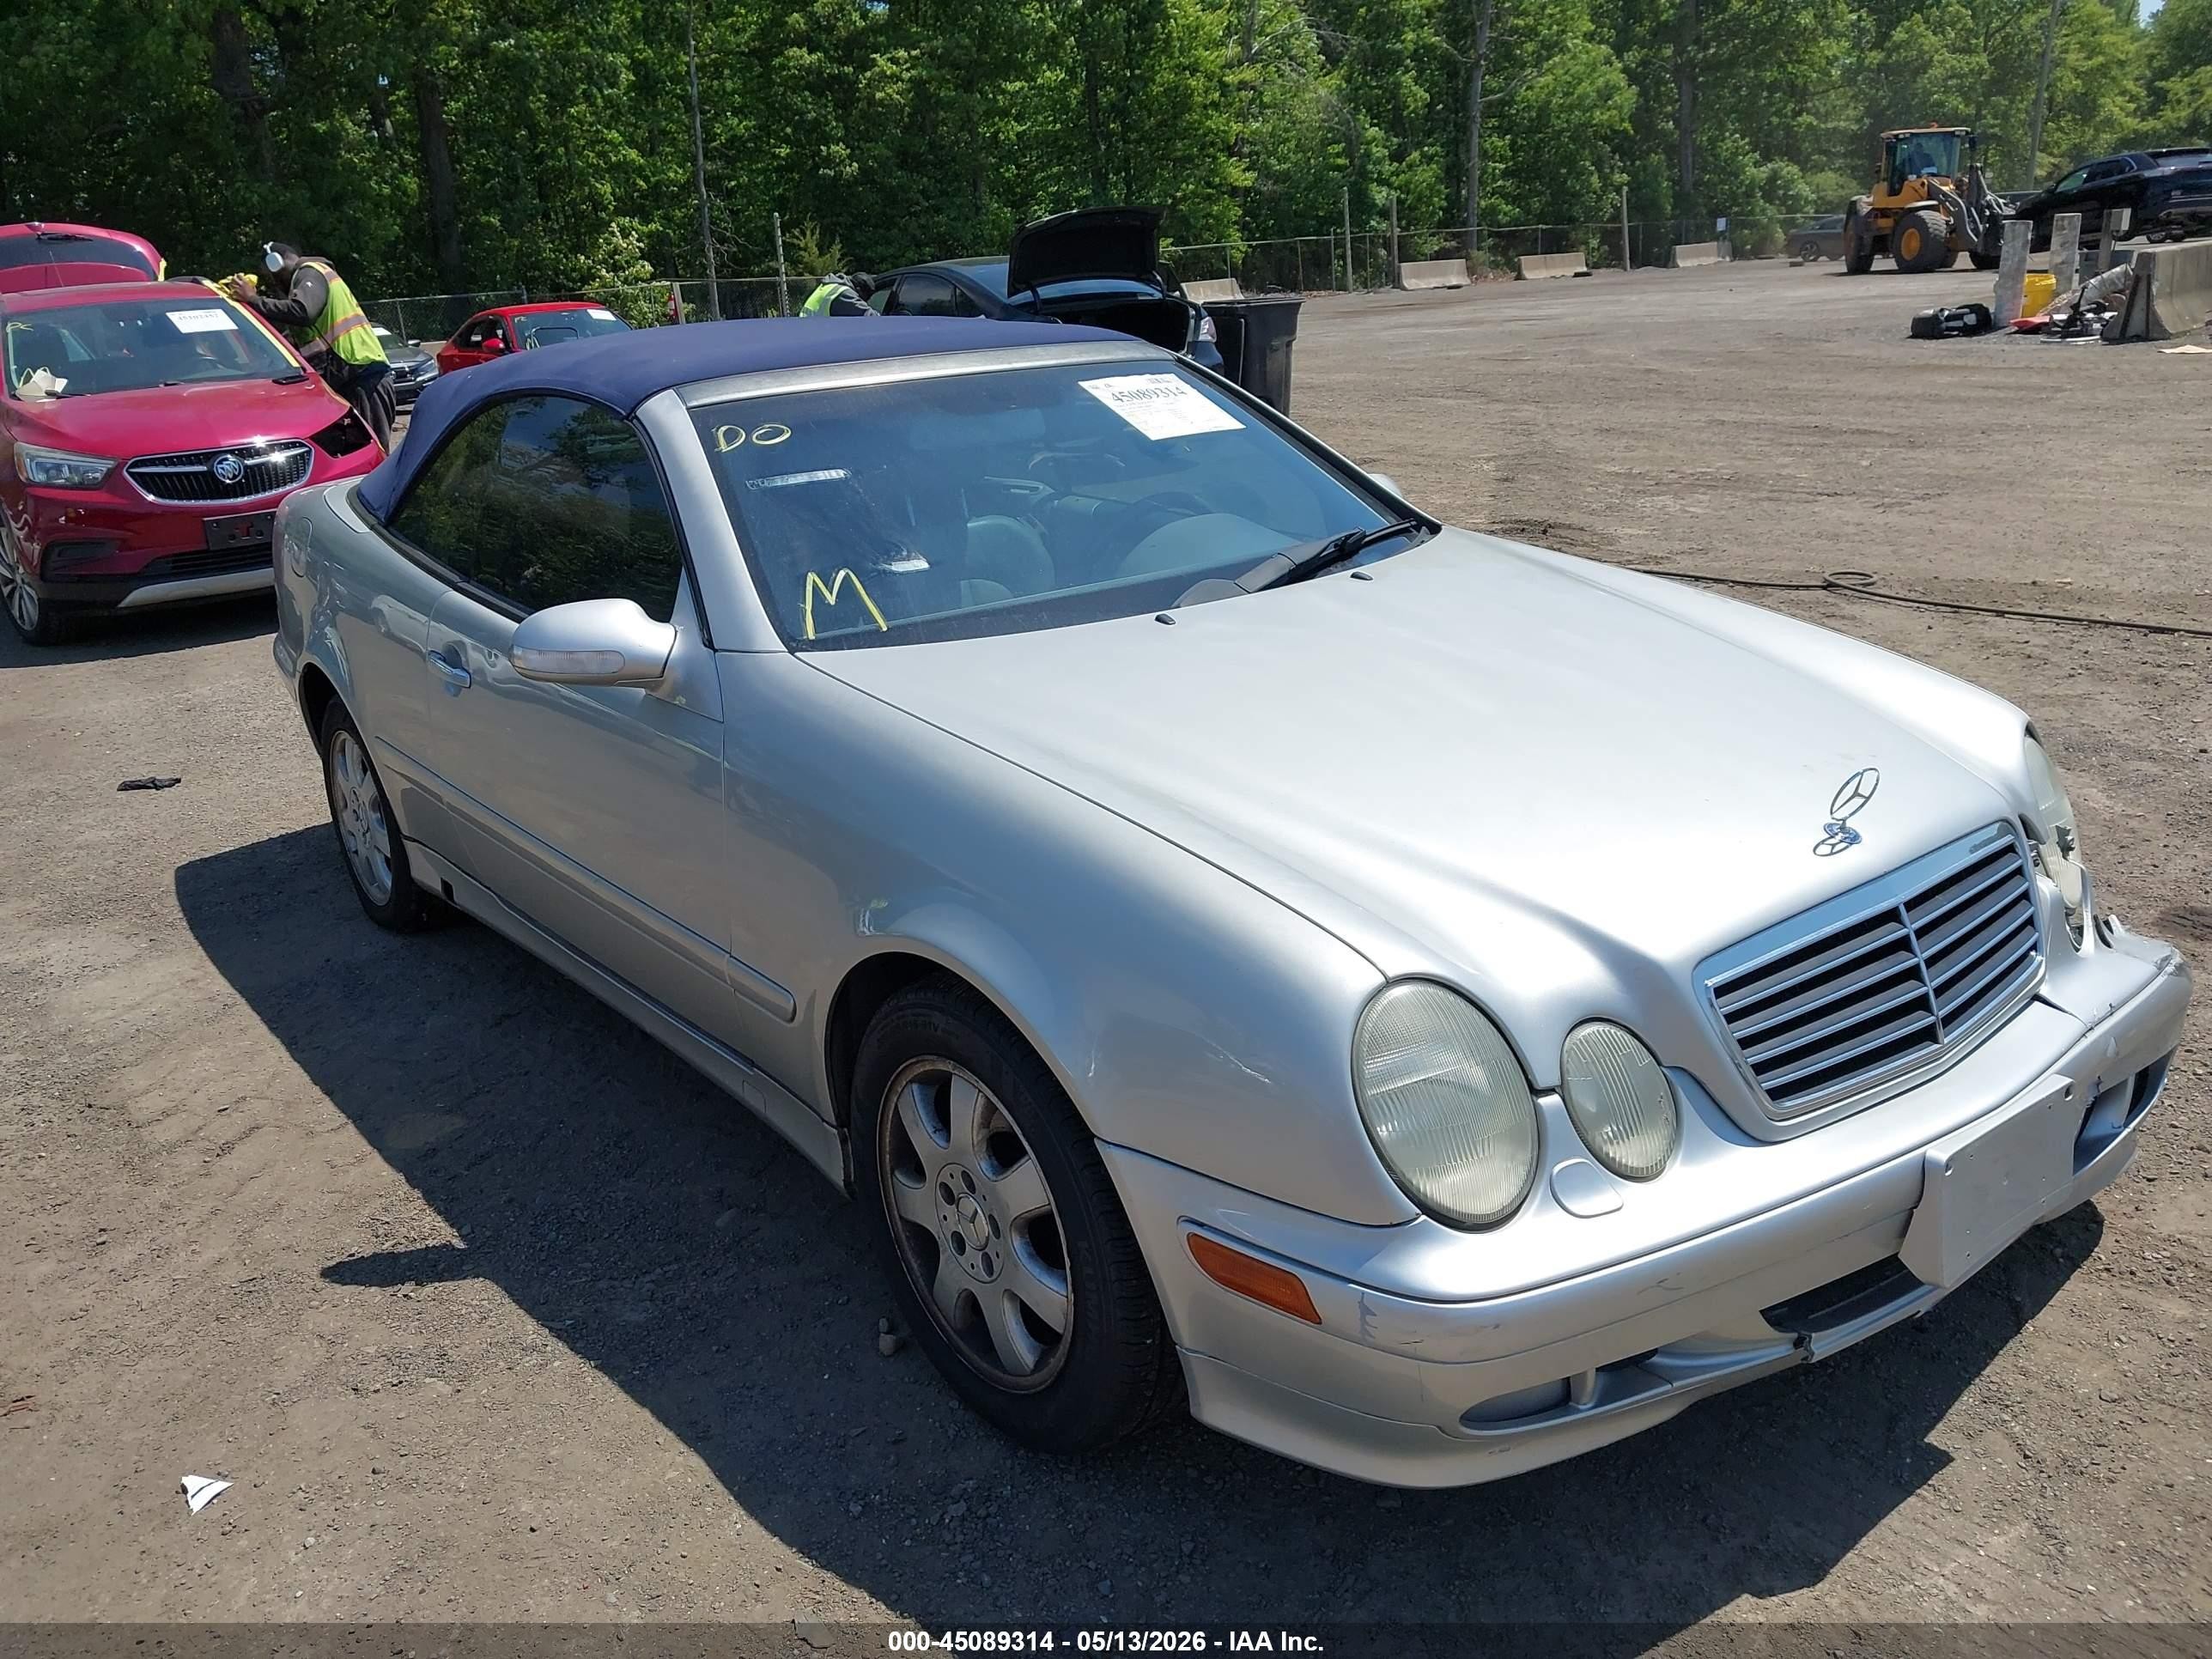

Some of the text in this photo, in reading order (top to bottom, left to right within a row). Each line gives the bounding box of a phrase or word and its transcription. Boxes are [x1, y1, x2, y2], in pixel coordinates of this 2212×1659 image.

[1111, 386, 1188, 403] 45089314
[712, 423, 792, 453] DO
[802, 568, 888, 641] M
